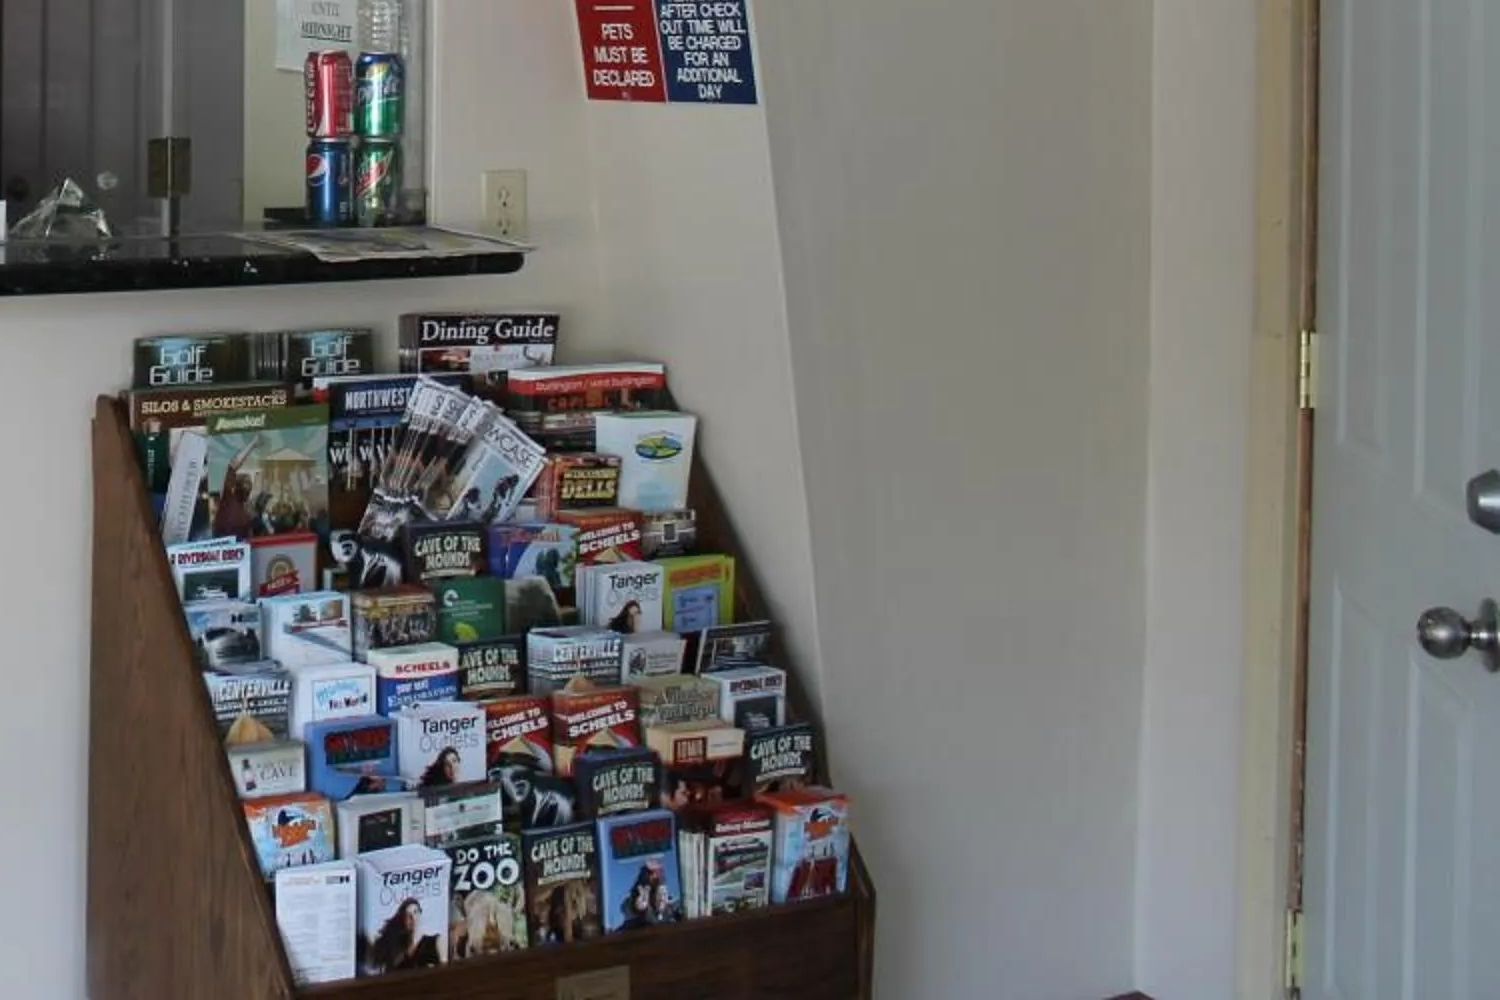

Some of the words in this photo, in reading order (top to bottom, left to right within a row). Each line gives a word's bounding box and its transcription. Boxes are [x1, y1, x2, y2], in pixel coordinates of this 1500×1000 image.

[660, 3, 698, 18] AFTER
[700, 2, 741, 17] CHECK
[601, 23, 633, 40] PETS
[660, 19, 684, 34] OUT
[687, 19, 715, 34] TIME
[718, 19, 746, 34] WILL
[668, 35, 685, 50] BE
[687, 35, 741, 50] CHARGED
[594, 47, 627, 64] MUST
[631, 46, 648, 64] BE
[684, 52, 708, 66] FOR
[712, 51, 729, 66] AN
[593, 70, 654, 87] DECLARED
[698, 83, 722, 100] DAY
[421, 319, 490, 344] Dining
[494, 317, 555, 339] Guide
[150, 364, 213, 386] Guide
[301, 356, 361, 377] Guide
[141, 399, 179, 414] SILOS
[181, 399, 191, 411] &
[193, 394, 287, 411] SMOKESTACKS
[622, 521, 635, 531] TO
[415, 537, 442, 557] CAVE
[443, 535, 459, 551] OF
[462, 535, 481, 552] THE
[579, 529, 640, 554] SCHEELS
[426, 551, 472, 569] MOUNDS
[609, 572, 660, 590] Tanger
[485, 648, 499, 664] OF
[501, 648, 520, 664] THE
[395, 660, 451, 674] SCHEELS
[487, 711, 525, 729] ELCOME
[525, 707, 541, 718] TO
[567, 707, 612, 724] WELCOME
[613, 700, 628, 711] TO
[420, 715, 479, 735] Tanger
[569, 709, 636, 738] SCHEELS
[750, 739, 775, 760] CAVE
[777, 736, 793, 752] OF
[794, 735, 812, 750] THE
[761, 751, 801, 772] MOUNDS
[592, 770, 618, 791] CAVE
[619, 768, 635, 784] OF
[636, 766, 654, 784] THE
[603, 782, 645, 801] MOUNDS
[456, 848, 479, 864] DO
[484, 842, 512, 859] THE
[531, 840, 560, 862] CAVE
[561, 838, 577, 854] OF
[577, 836, 594, 852] THE
[454, 857, 520, 892] ZOO
[543, 855, 587, 876] MOUNDS
[382, 866, 444, 888] Tanger
